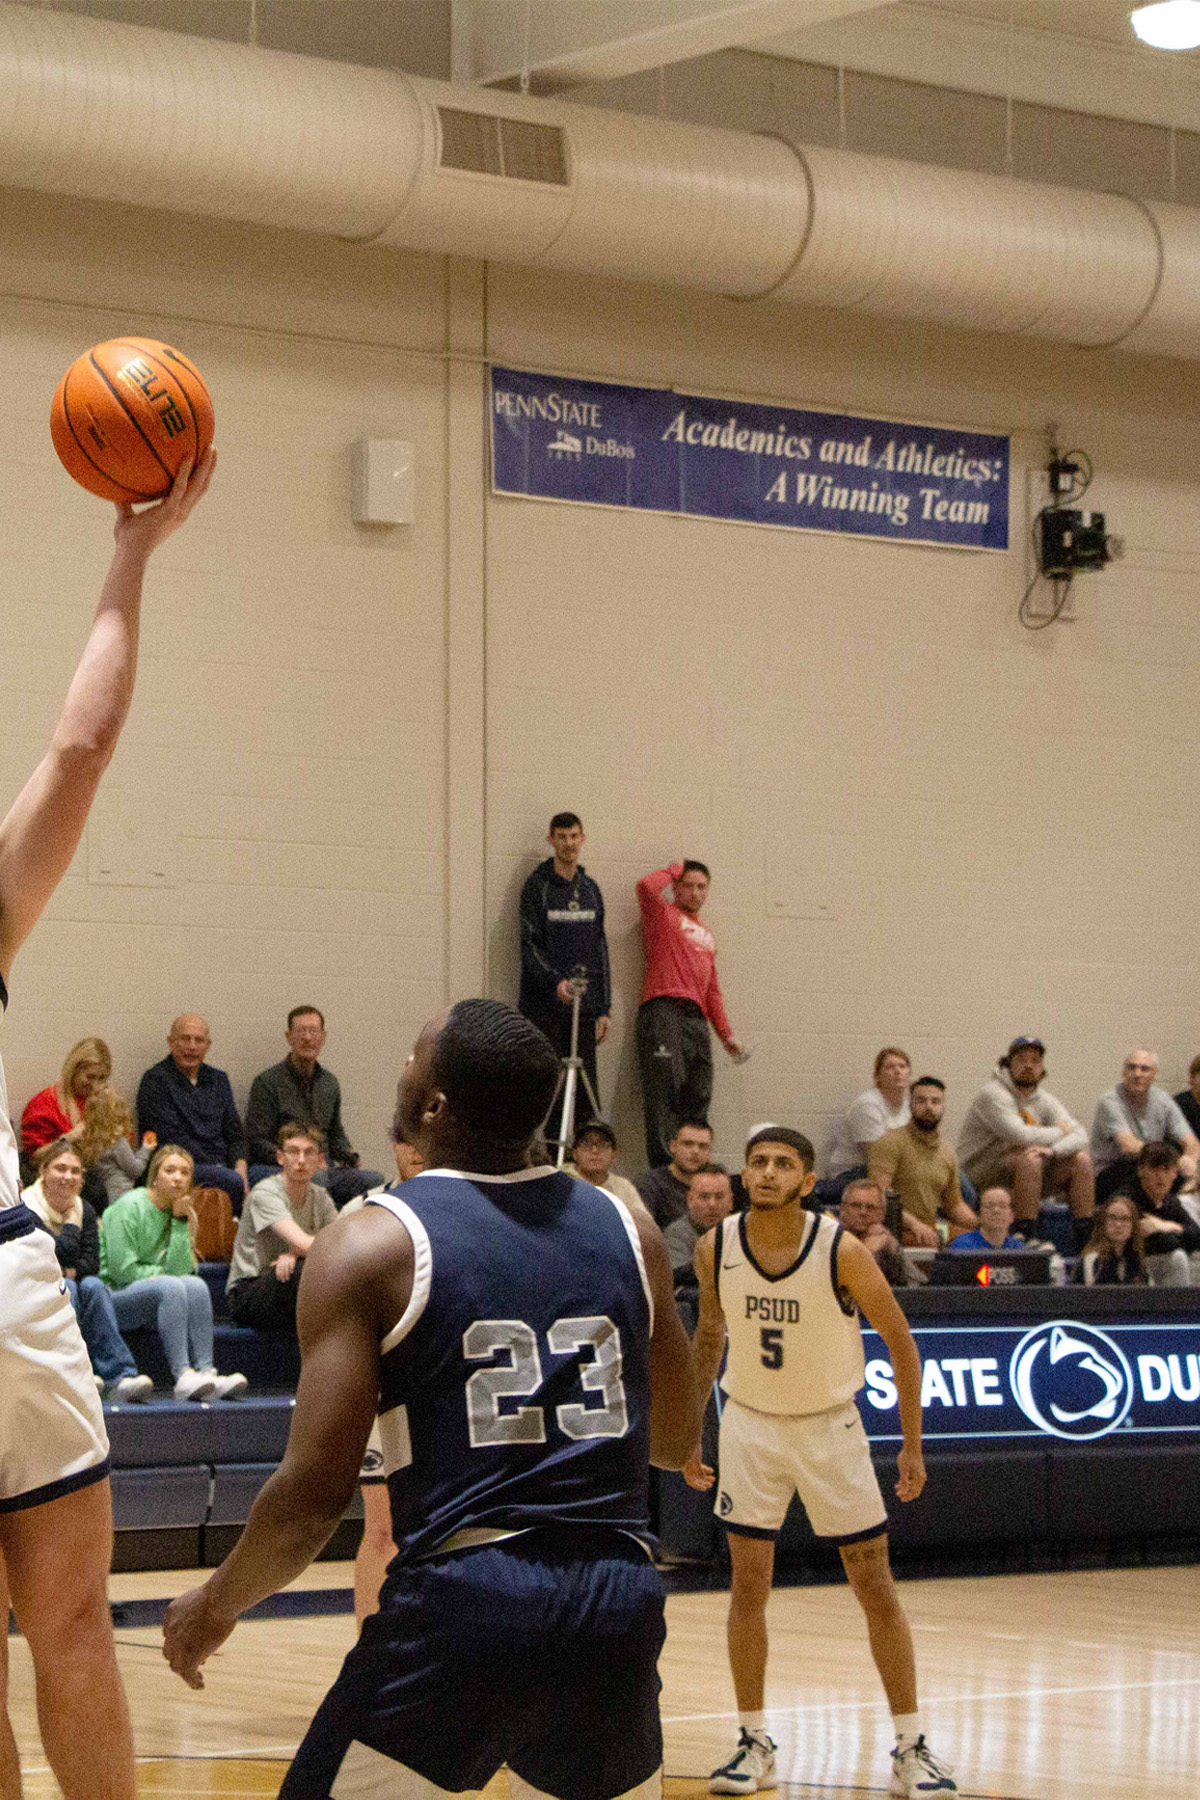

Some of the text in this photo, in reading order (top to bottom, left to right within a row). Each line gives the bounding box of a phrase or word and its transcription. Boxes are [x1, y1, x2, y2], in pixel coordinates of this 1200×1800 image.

[124, 357, 187, 438] ELITE
[586, 436, 636, 460] DuBois
[662, 410, 1003, 483] Academics and Athletics:
[765, 471, 990, 527] A Winning Team
[745, 1295, 800, 1324] PSUD
[761, 1329, 783, 1370] 5
[462, 1315, 629, 1448] 23
[864, 1358, 1003, 1409] SATE
